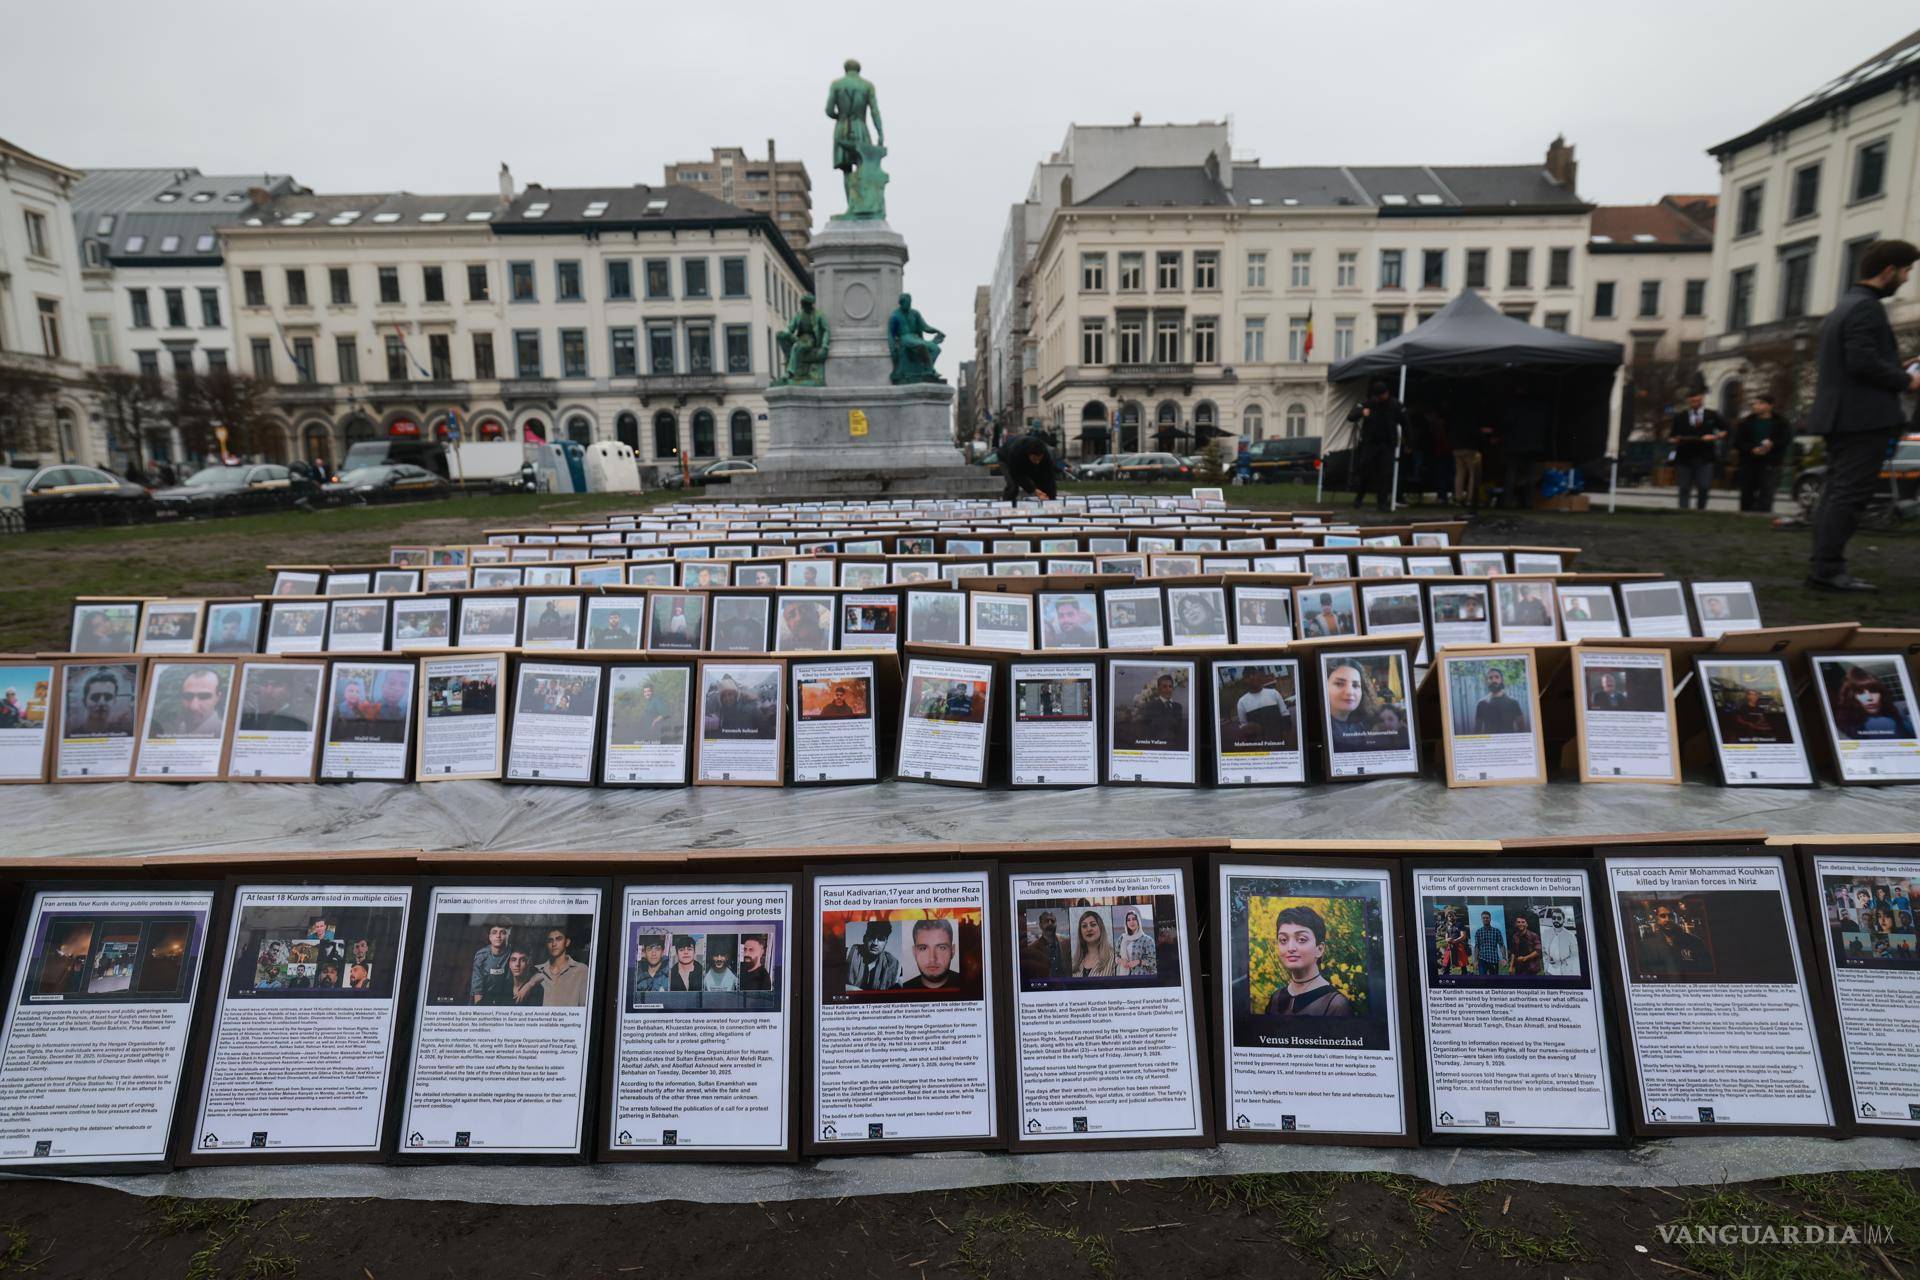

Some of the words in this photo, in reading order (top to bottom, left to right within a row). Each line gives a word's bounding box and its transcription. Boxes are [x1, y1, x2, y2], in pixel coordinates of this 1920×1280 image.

[1141, 876, 1162, 884] family,
[1429, 875, 1446, 883] Four
[1447, 875, 1474, 883] Kurdish
[1543, 876, 1571, 884] treating
[1659, 878, 1670, 886] by
[1019, 887, 1049, 896] including
[1458, 884, 1499, 893] government
[351, 894, 382, 902] multiple
[661, 897, 687, 905] forces
[862, 898, 871, 906] by
[632, 908, 640, 916] in
[641, 908, 684, 916] Behbahan
[708, 907, 744, 916] ongoing
[746, 907, 781, 916] protests
[1259, 1035, 1289, 1044] Venus
[1290, 1035, 1363, 1045] Hosseinnezhad
